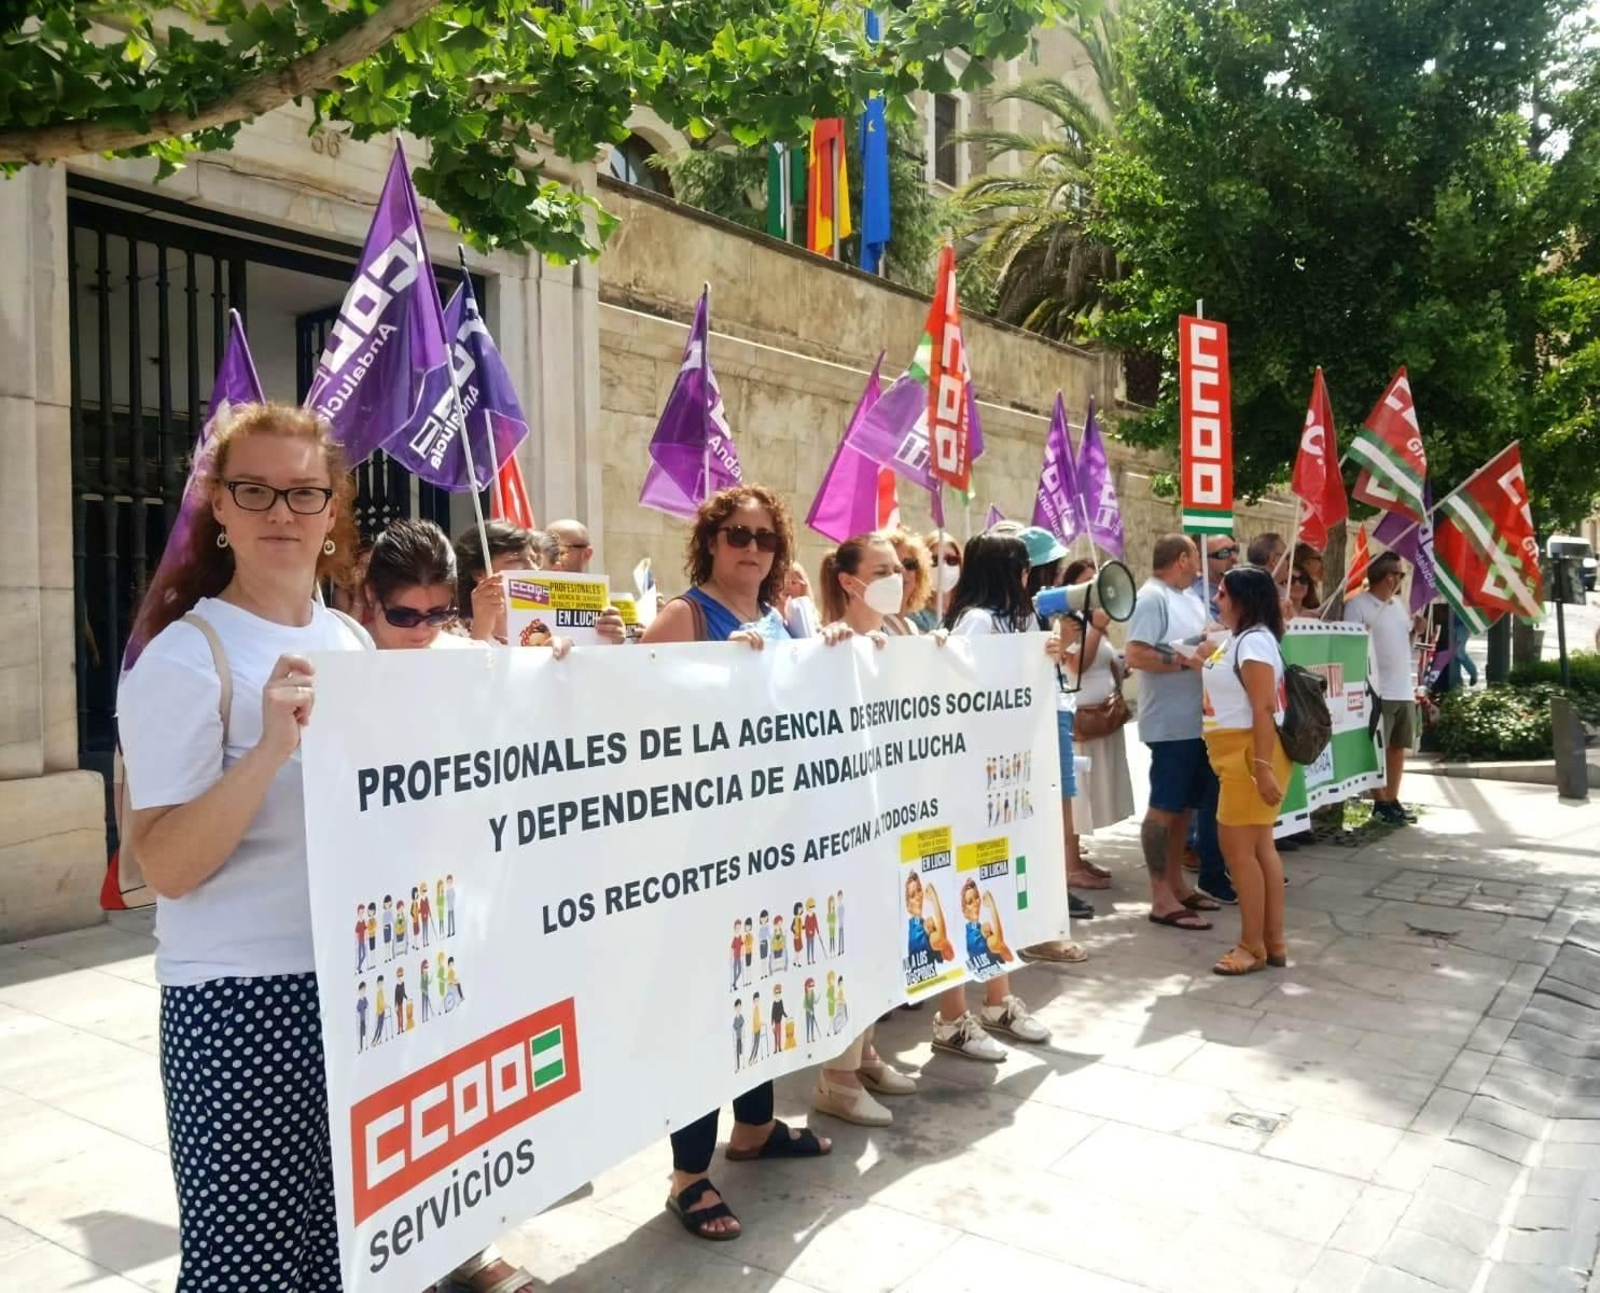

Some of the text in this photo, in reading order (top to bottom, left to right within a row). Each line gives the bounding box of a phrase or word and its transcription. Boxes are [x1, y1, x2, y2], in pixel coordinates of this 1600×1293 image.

[1190, 323, 1222, 505] CCOO
[558, 610, 571, 625] EN
[358, 687, 1032, 812] PROFESIONALES DE LA AGENCIA DE SERVICIOS SOCIALES
[489, 814, 508, 852] Y
[517, 774, 743, 846] DEPENDENCIA
[751, 766, 784, 798] DE
[885, 741, 904, 767] EN
[909, 732, 967, 762] LUCHA
[543, 892, 596, 934] LOS
[605, 856, 741, 916] RECORTES
[748, 843, 795, 876] NOS
[803, 820, 871, 863] AFECTAN
[922, 851, 951, 871] EN LUCHA
[989, 861, 1008, 877] LUCHA
[365, 1042, 528, 1190] CCOO
[370, 1138, 535, 1273] servicios
